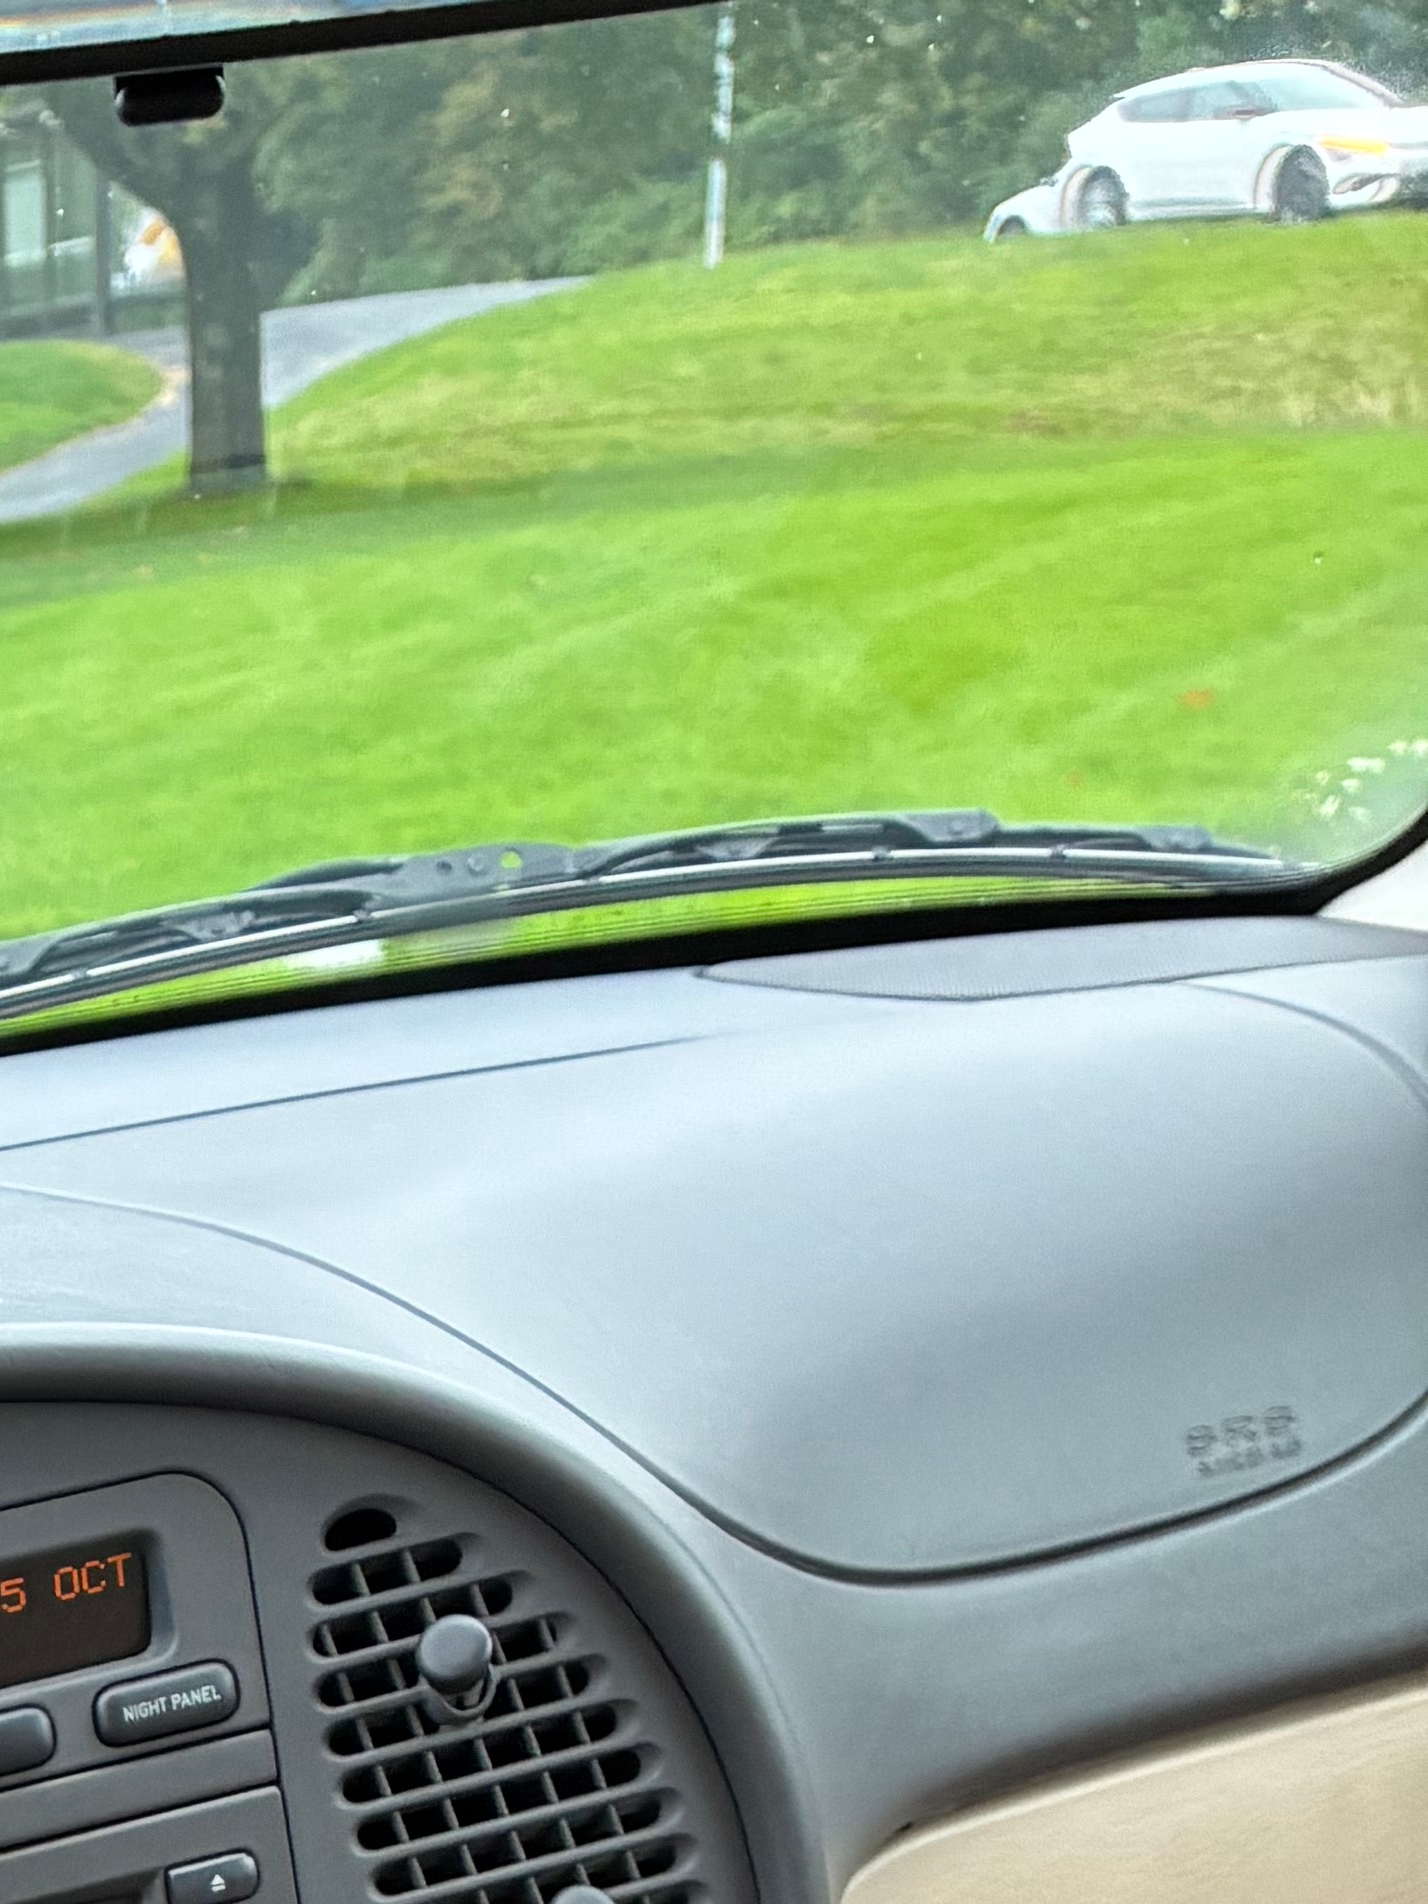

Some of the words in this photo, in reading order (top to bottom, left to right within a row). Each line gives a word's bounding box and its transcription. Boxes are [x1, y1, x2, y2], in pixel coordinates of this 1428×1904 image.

[0, 1578, 28, 1614] 5
[53, 1552, 133, 1602] OCT
[121, 1696, 168, 1724] NIGHT
[170, 1684, 223, 1711] PANEL
